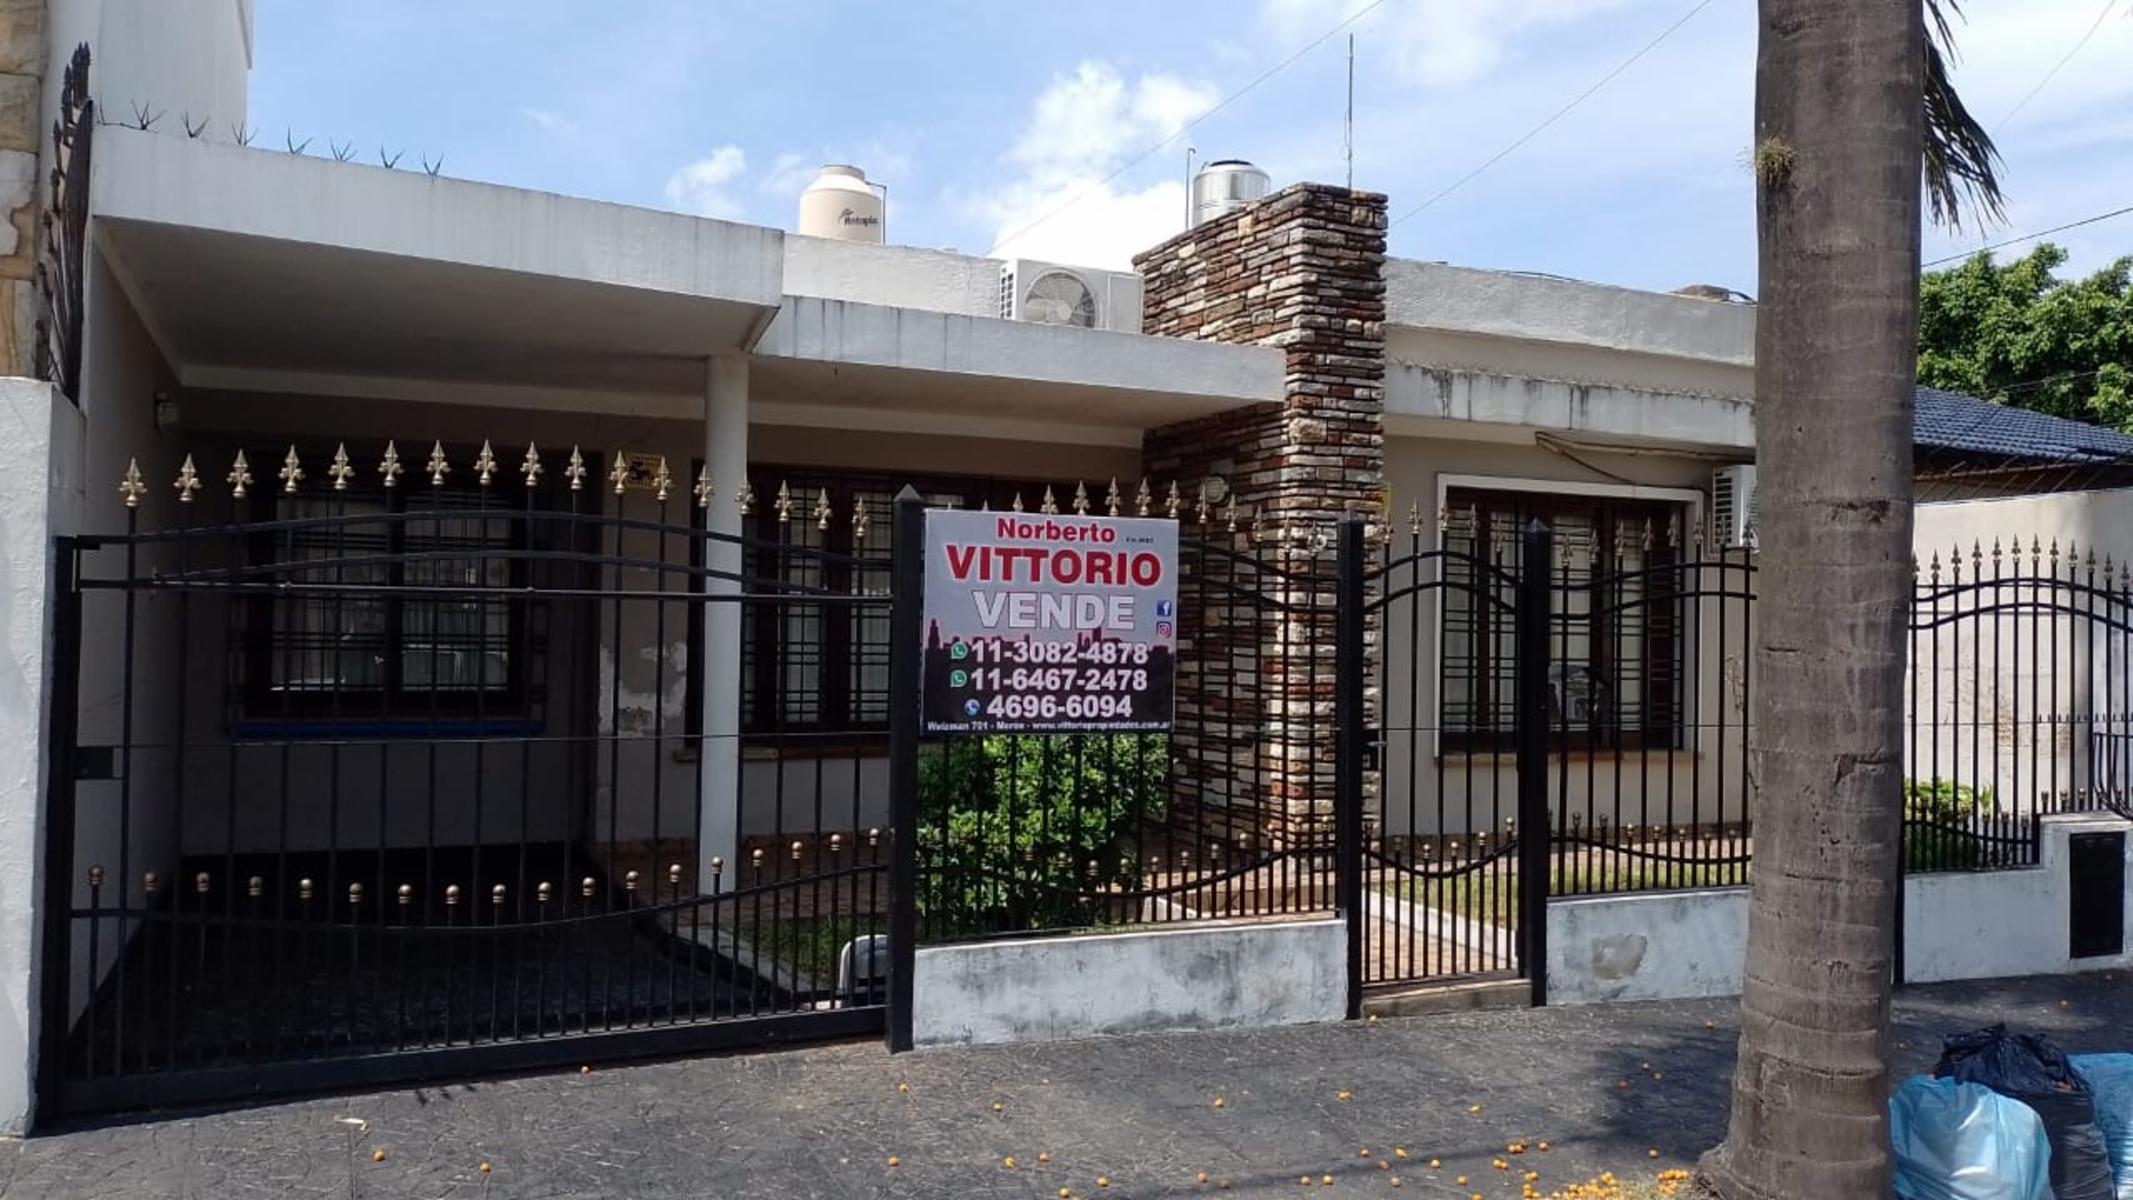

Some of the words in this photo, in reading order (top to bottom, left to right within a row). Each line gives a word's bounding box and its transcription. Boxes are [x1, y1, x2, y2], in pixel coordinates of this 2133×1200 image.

[997, 518, 1116, 543] Norberto
[945, 544, 1162, 587] VITTORIO
[972, 590, 1136, 630] VENDE
[971, 640, 1148, 664] 11-3082-4878
[971, 668, 1148, 691] 11-6467-2478
[986, 695, 1133, 718] 4696-6094
